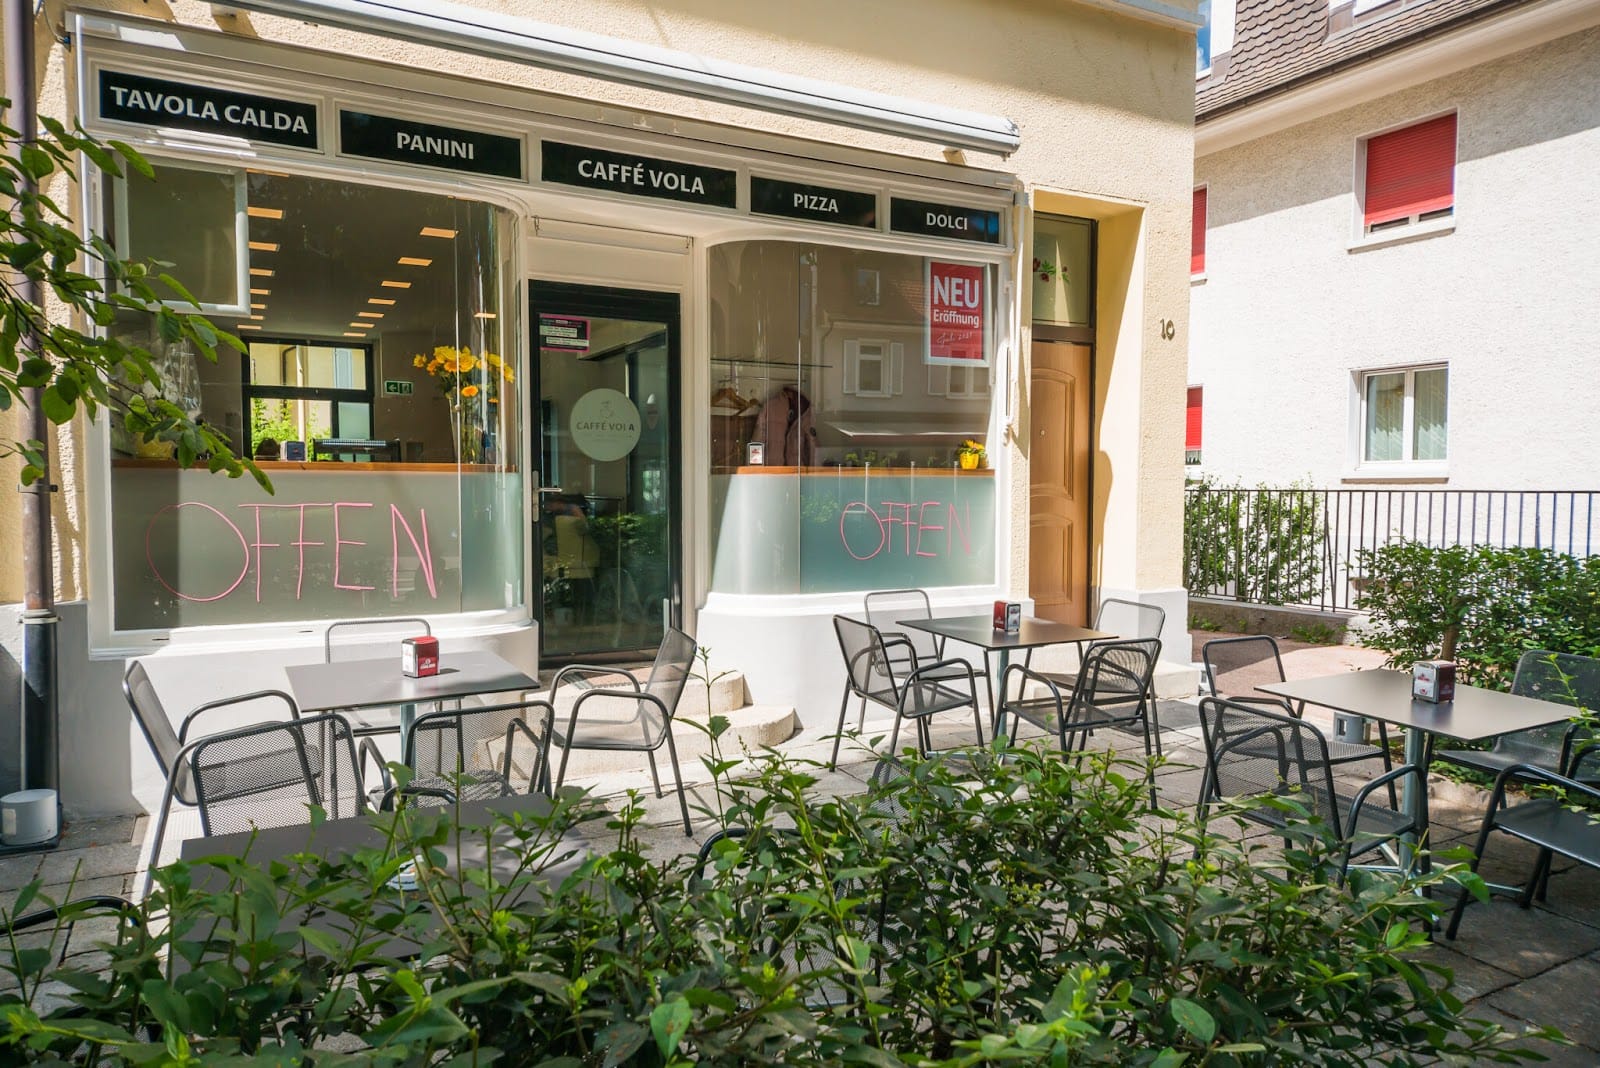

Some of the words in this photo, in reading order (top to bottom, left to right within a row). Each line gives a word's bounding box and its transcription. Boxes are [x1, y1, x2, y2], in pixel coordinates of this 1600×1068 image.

[109, 85, 219, 121] TAVOLA
[224, 105, 310, 134] CALDA
[396, 132, 474, 160] PANINI
[577, 159, 645, 186] CAFFÉ
[649, 169, 705, 195] VOLA
[793, 193, 839, 213] PIZZA
[926, 212, 968, 231] DOLCI
[933, 275, 980, 309] NEU
[933, 308, 980, 329] Eröffnung
[1160, 318, 1175, 341] 10
[576, 421, 606, 431] CAFFÉ
[840, 500, 971, 560] OFFEN
[146, 502, 437, 603] OFFEN
